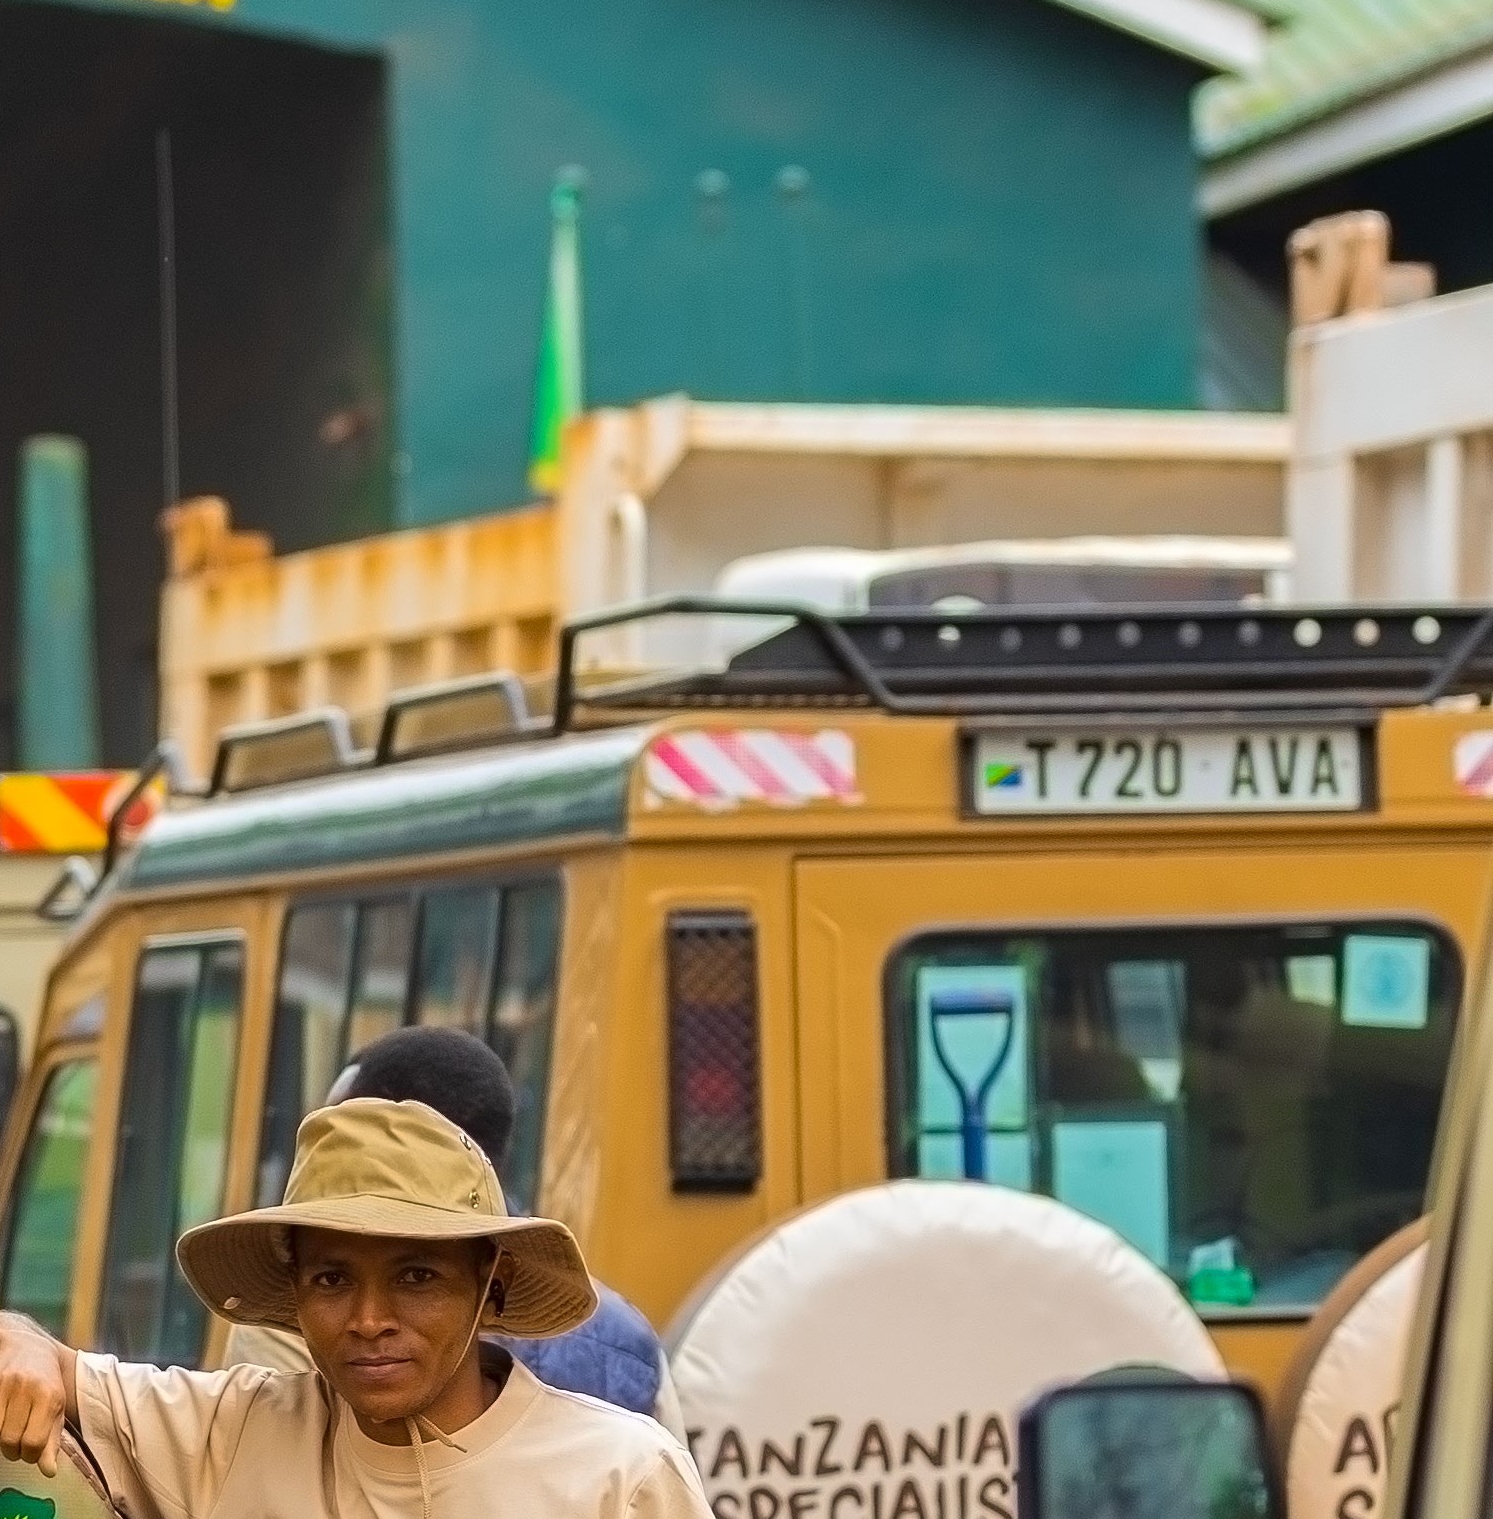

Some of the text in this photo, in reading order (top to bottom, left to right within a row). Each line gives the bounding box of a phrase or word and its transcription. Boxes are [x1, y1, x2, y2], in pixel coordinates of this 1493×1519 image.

[1025, 736, 1341, 797] T 720 AVA
